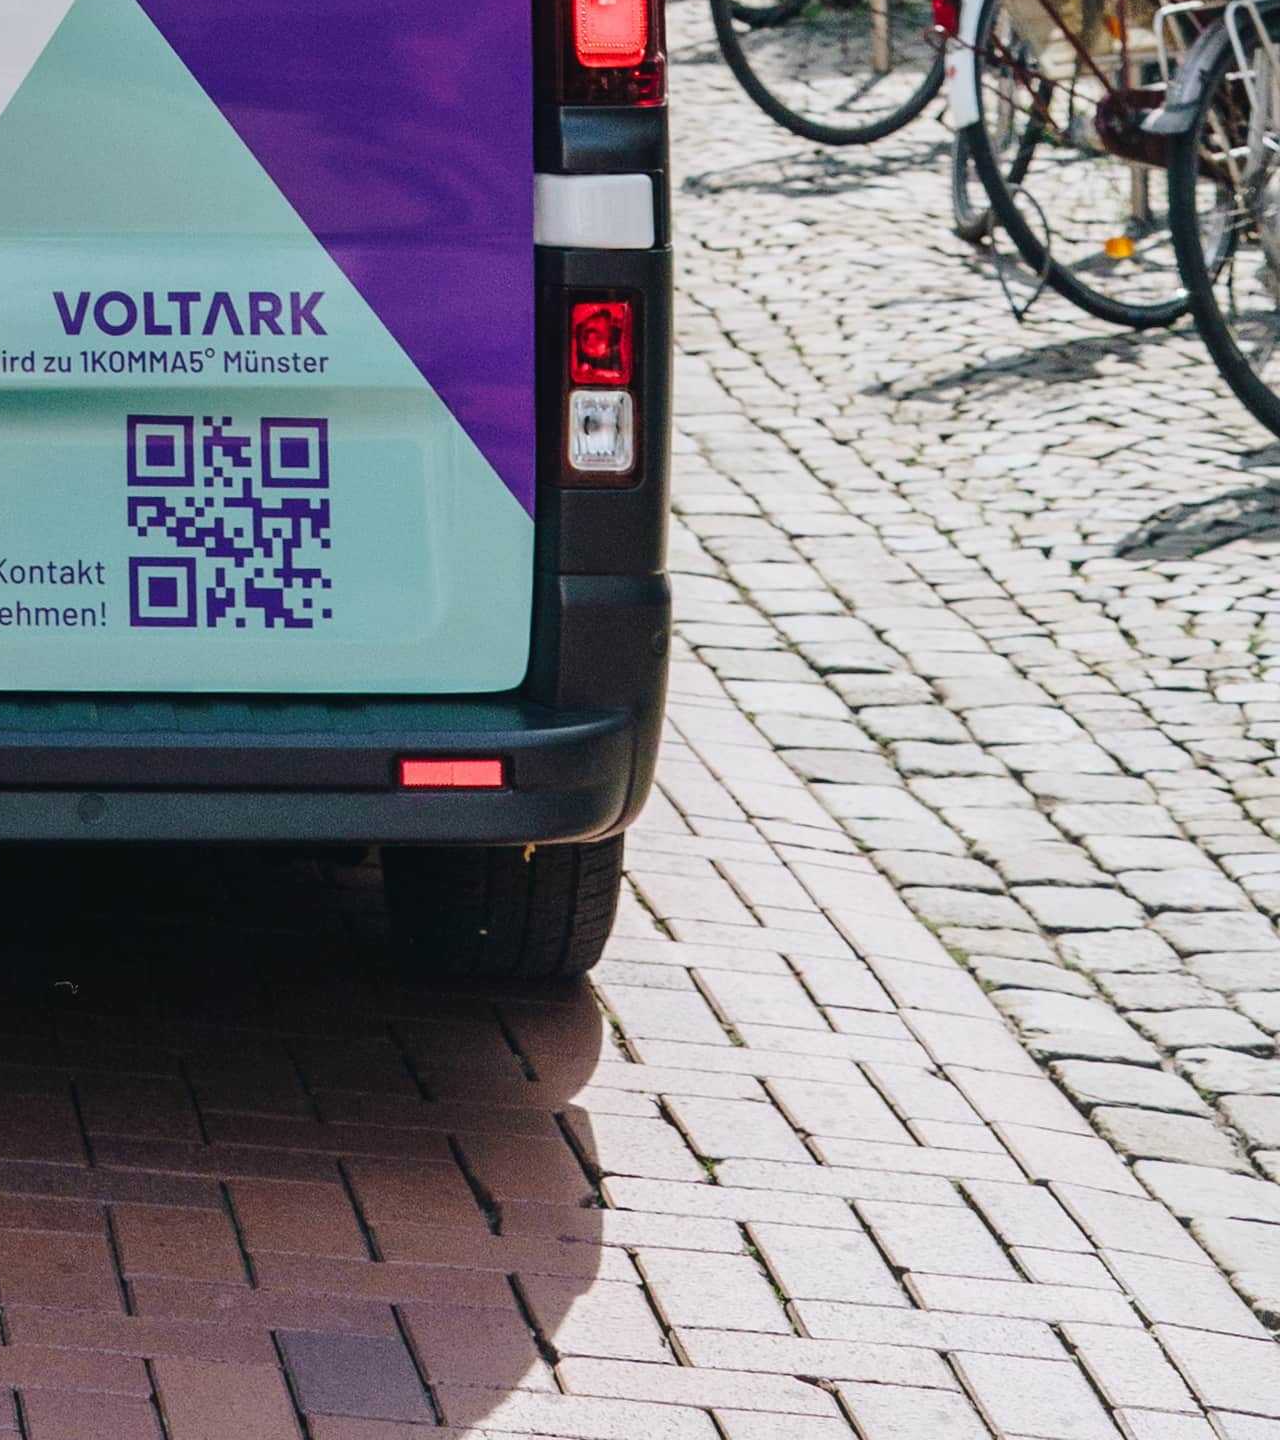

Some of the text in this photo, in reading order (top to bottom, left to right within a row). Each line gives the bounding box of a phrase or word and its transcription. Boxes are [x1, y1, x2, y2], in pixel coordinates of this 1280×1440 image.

[52, 291, 328, 336] VOLTARK
[43, 356, 72, 373] zu
[80, 348, 215, 373] 1KOMMA5°
[223, 350, 329, 373] Münster
